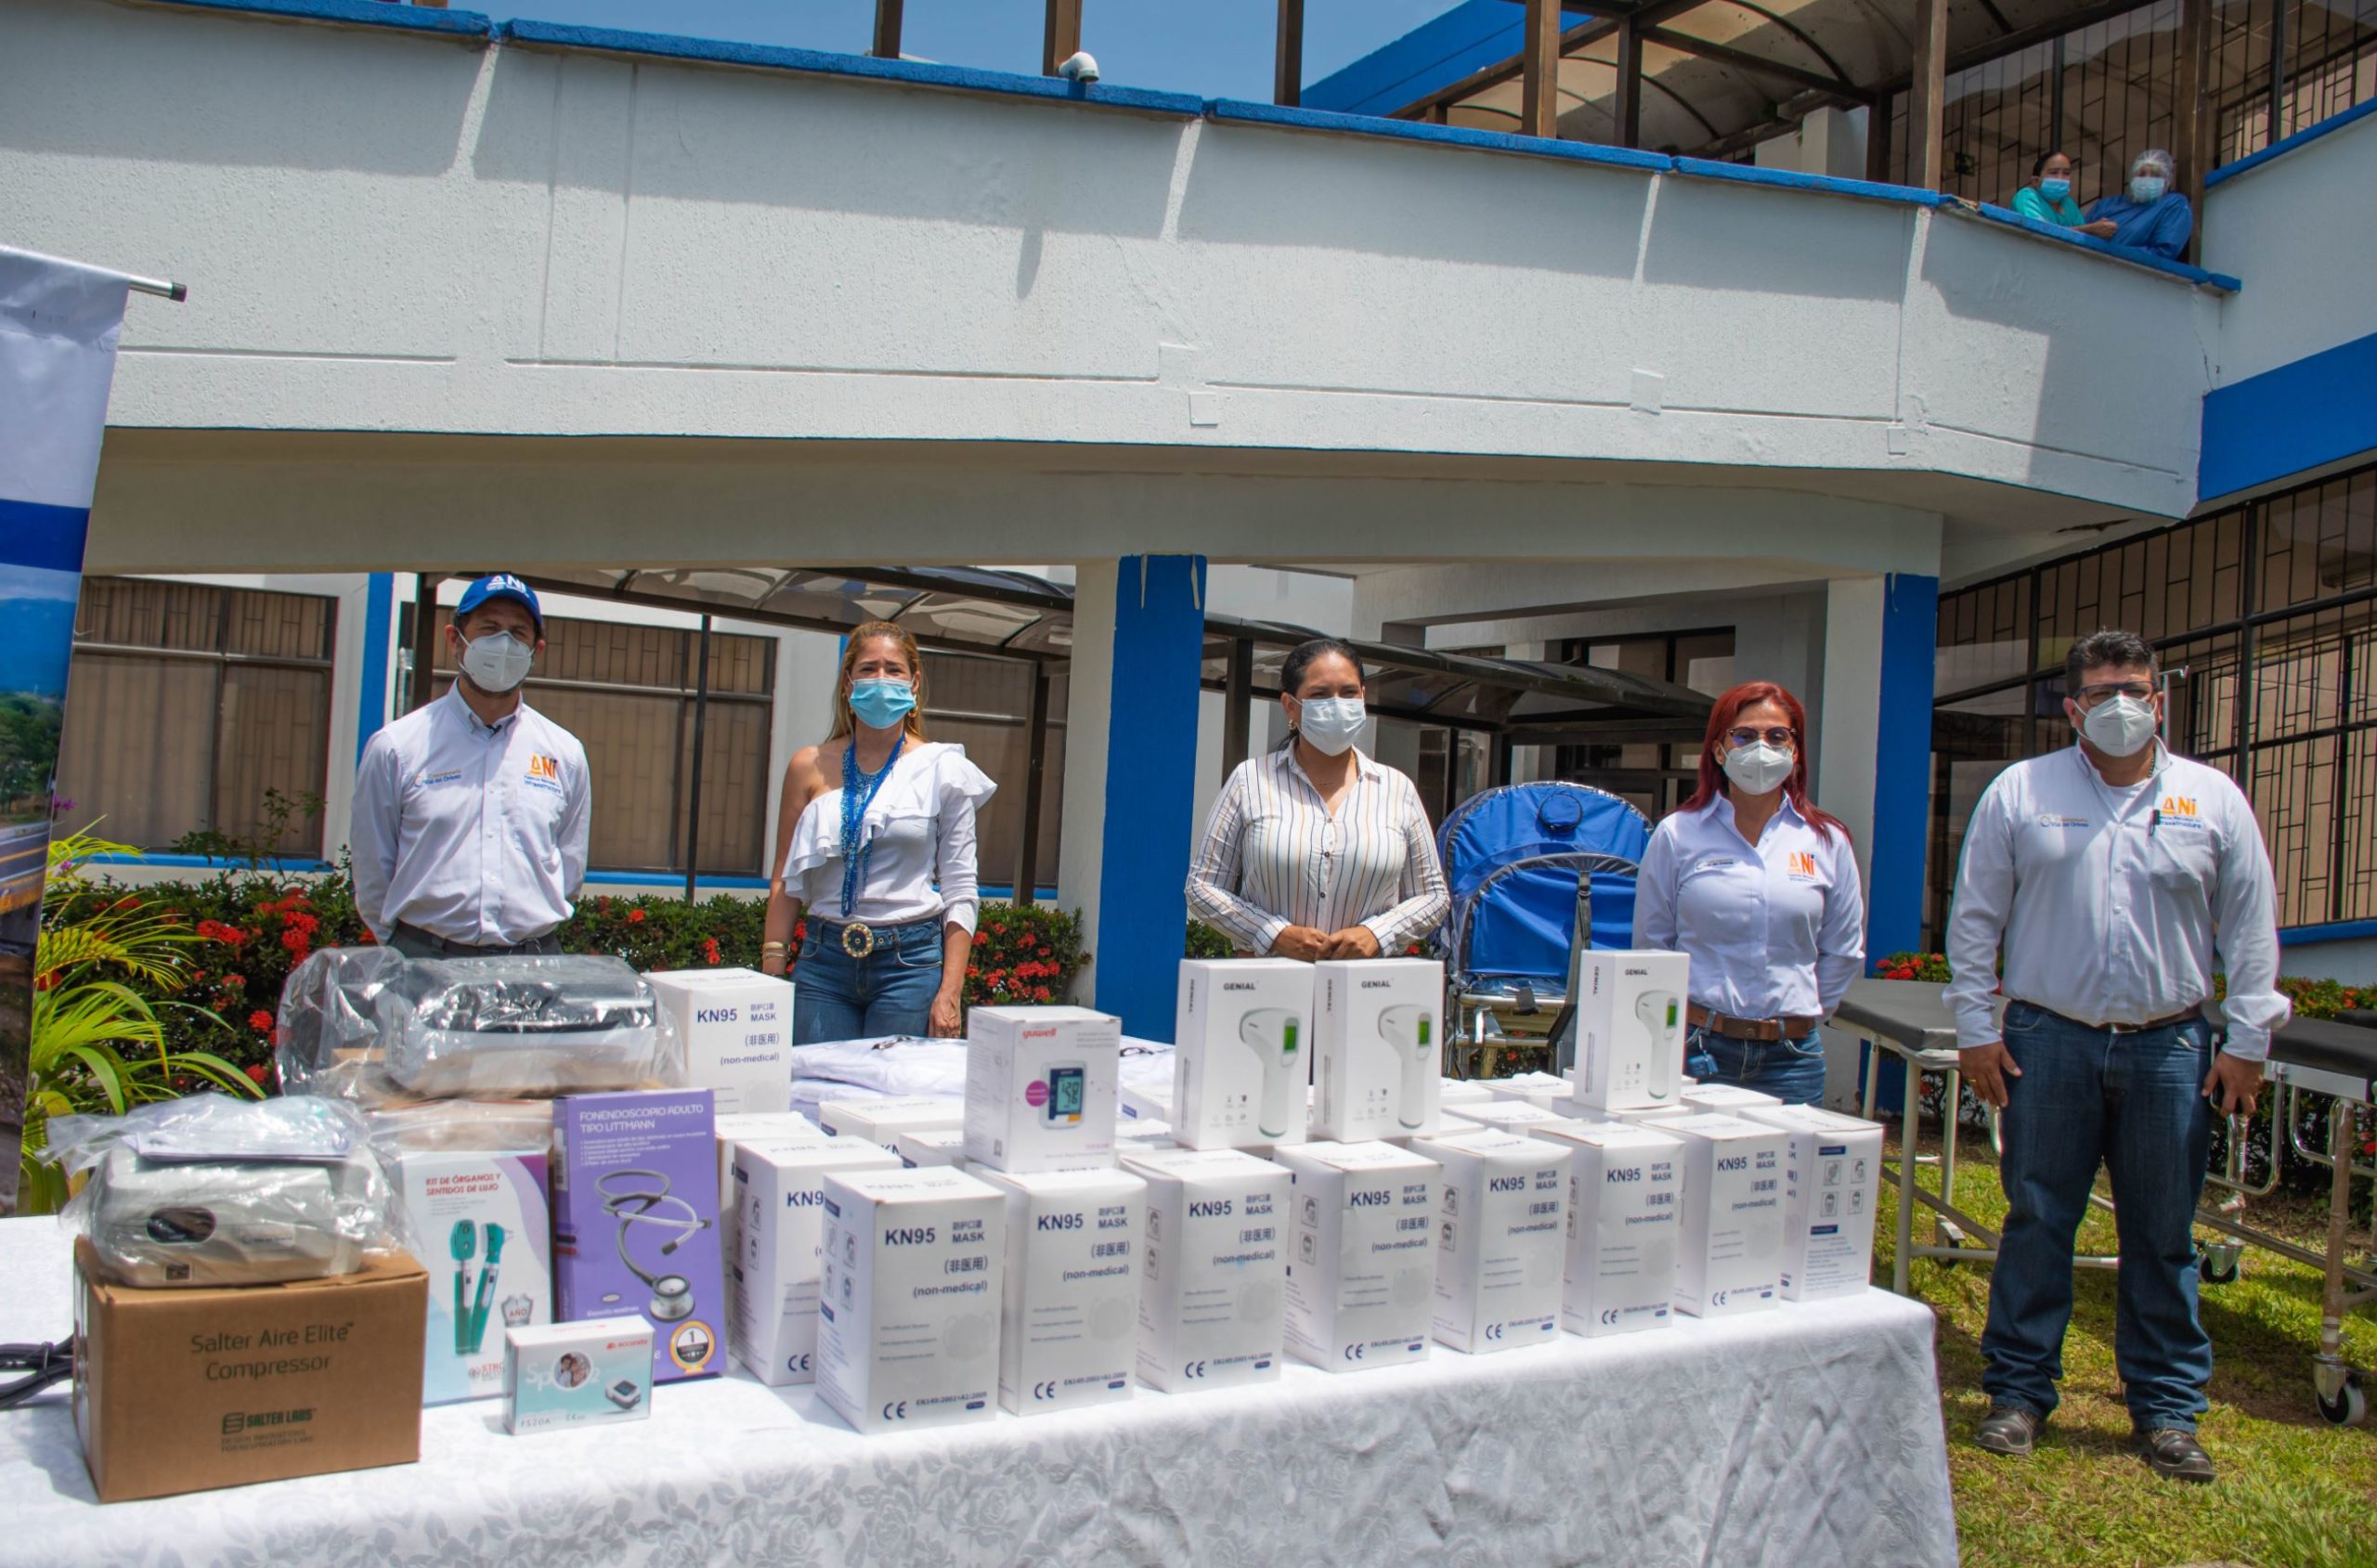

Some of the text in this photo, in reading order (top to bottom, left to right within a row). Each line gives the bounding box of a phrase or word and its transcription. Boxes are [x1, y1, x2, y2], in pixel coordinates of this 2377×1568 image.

[1223, 982, 1256, 991] GENIAL
[1361, 980, 1391, 989] GENIAL
[697, 1008, 738, 1023] KN95
[750, 1012, 777, 1022] MASK
[1023, 1028, 1057, 1040] yuwell
[720, 1053, 780, 1068] (non-medical)
[579, 1104, 704, 1121] FONENDOSCOPIO ADULTO
[580, 1120, 656, 1134] TIPO LITTMANN
[1717, 1157, 1747, 1172] KN95
[1756, 1160, 1776, 1169] MASK
[425, 1173, 501, 1186] KIT DE ÓRGANOS Y
[1606, 1168, 1641, 1183] KN95
[1650, 1172, 1672, 1182] MASK
[426, 1186, 464, 1196] SENTIDOS
[466, 1185, 476, 1193] DE
[1489, 1176, 1526, 1192] KN95
[1535, 1180, 1558, 1190] MASK
[786, 1190, 825, 1207] KN9
[1350, 1190, 1391, 1207] KN95
[1402, 1194, 1427, 1205] MASK
[1732, 1198, 1776, 1211] (non-medical)
[1188, 1200, 1232, 1217] KN95
[1245, 1204, 1273, 1215] MASK
[1037, 1212, 1084, 1231] KN95
[1098, 1217, 1128, 1229] MASK
[1625, 1212, 1673, 1226] (non-medical)
[1507, 1221, 1558, 1237] (non-medical)
[885, 1227, 936, 1246] KN95
[952, 1231, 985, 1244] MASK
[1371, 1238, 1428, 1253] (non-medical)
[1213, 1250, 1275, 1266] (non-medical)
[1062, 1264, 1129, 1282] (non-medical)
[913, 1280, 988, 1299] (non-medical)
[509, 1307, 527, 1316] AÑO
[190, 1332, 252, 1354] Salter
[258, 1328, 299, 1347] Aire
[617, 1338, 648, 1349] accurate
[688, 1330, 695, 1343] 1
[205, 1355, 331, 1380] Compressor
[246, 1409, 284, 1428] SALTER
[520, 1417, 552, 1428] FS20A
